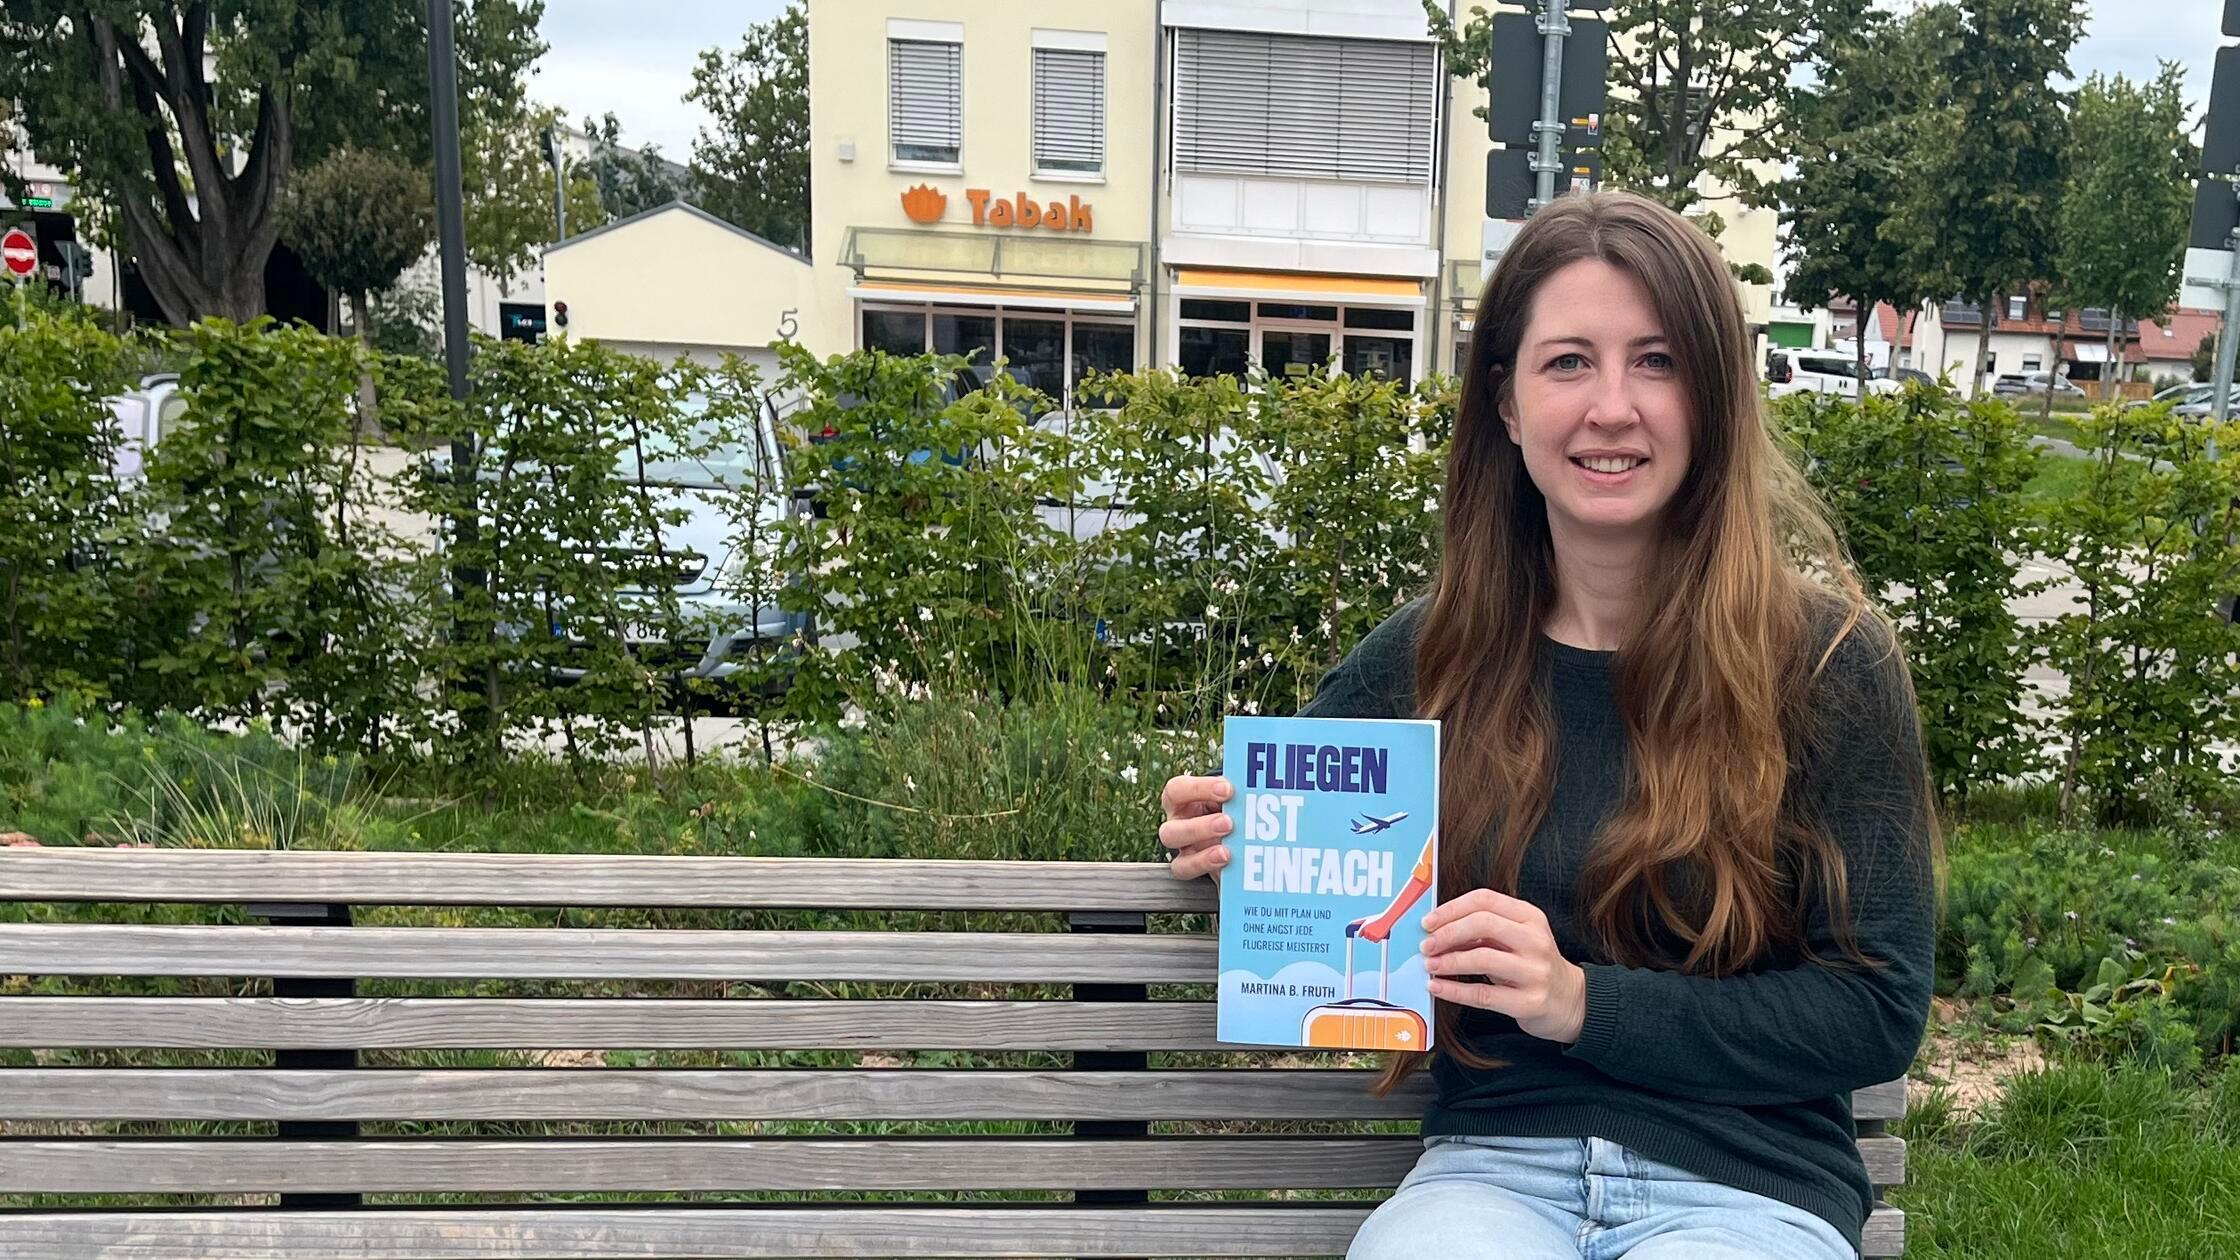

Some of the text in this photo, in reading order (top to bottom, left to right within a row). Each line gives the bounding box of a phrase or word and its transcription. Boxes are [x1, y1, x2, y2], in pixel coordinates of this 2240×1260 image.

[966, 189, 1093, 234] Tabak
[776, 307, 799, 338] 5
[1246, 742, 1388, 794] FLIEGEN
[1244, 793, 1305, 842] IST
[1243, 845, 1394, 897] EINFACH
[1244, 906, 1332, 920] WIE DU MIT PLAN UND
[1243, 923, 1314, 936] OHNE ANGST JEDE
[1243, 939, 1331, 954] FLUGREISE MEISTERST
[1241, 982, 1336, 998] MARTINA B. FRUTH
